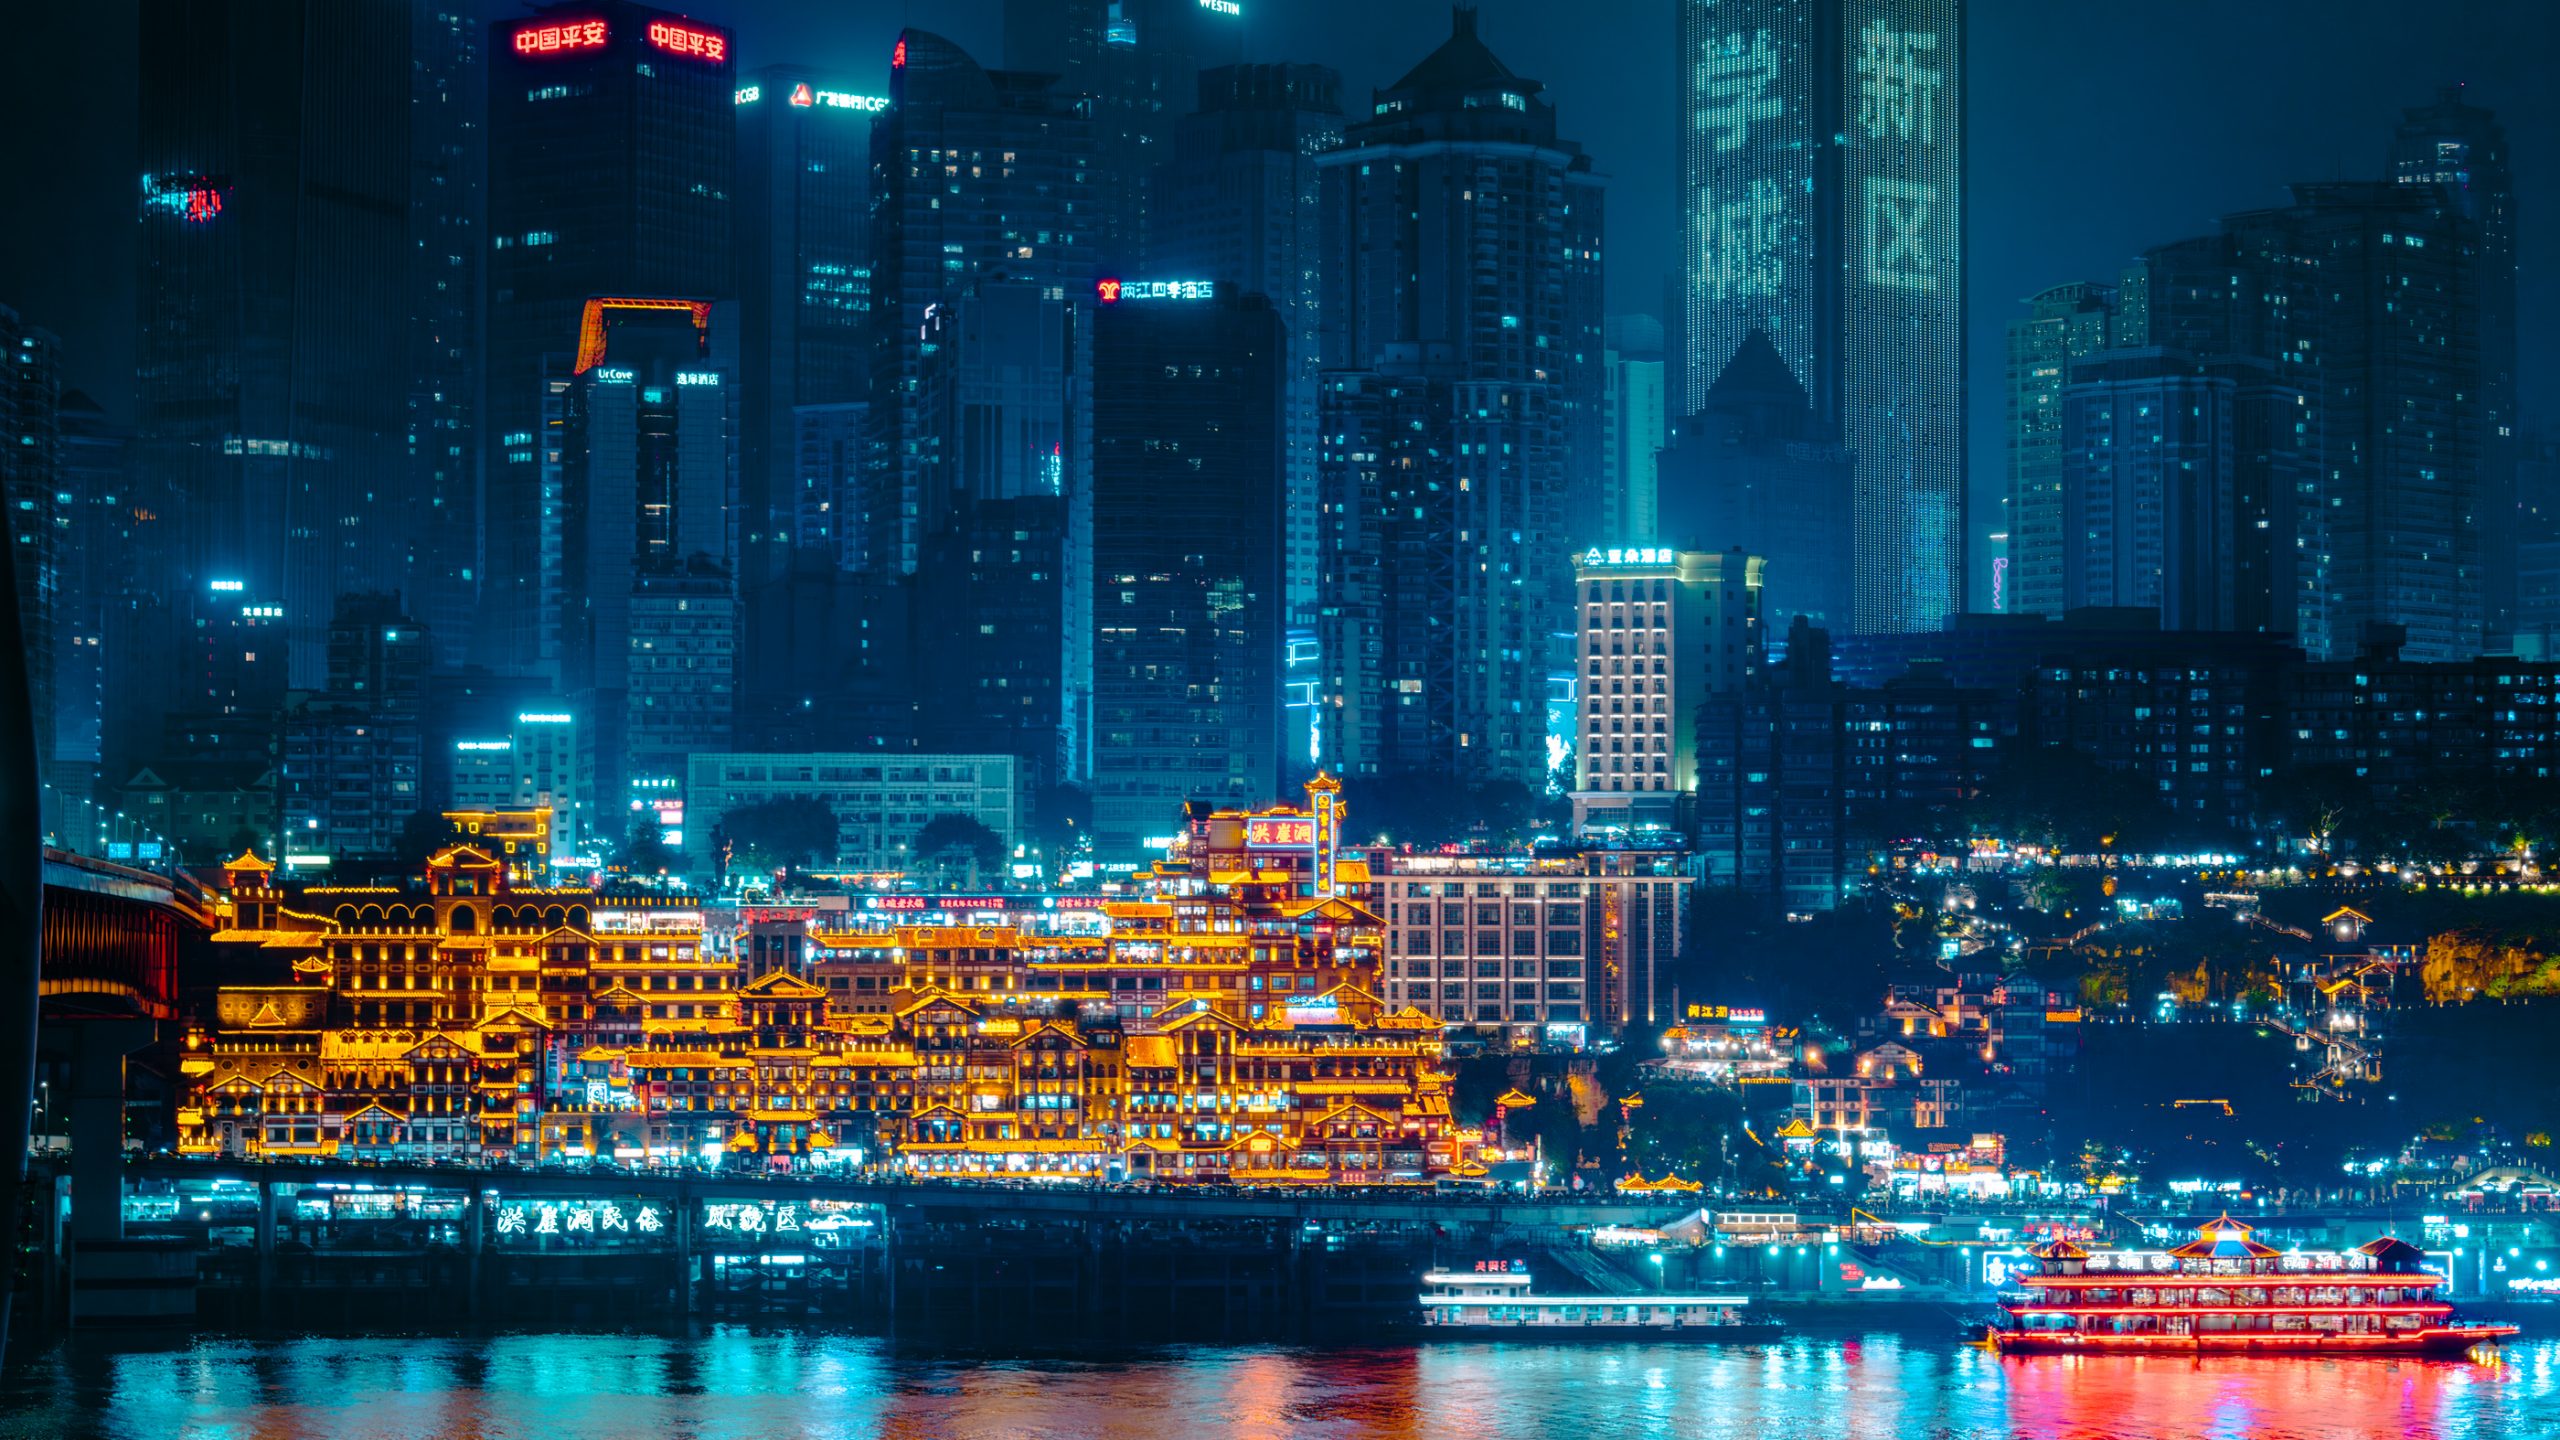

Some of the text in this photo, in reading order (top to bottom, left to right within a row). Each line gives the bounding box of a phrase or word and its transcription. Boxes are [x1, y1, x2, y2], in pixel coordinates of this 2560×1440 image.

[515, 21, 606, 54] 中国平安
[650, 23, 724, 61] 中国平安
[740, 86, 760, 102] CGB
[1120, 280, 1214, 299] 两江四季酒店
[597, 369, 634, 380] UrCove
[1607, 548, 1673, 564] 亚朵酒店
[1251, 822, 1312, 844] 洪崖洞
[496, 1205, 665, 1234] 洪崖洞民俗
[704, 1204, 800, 1233] 风貌区
